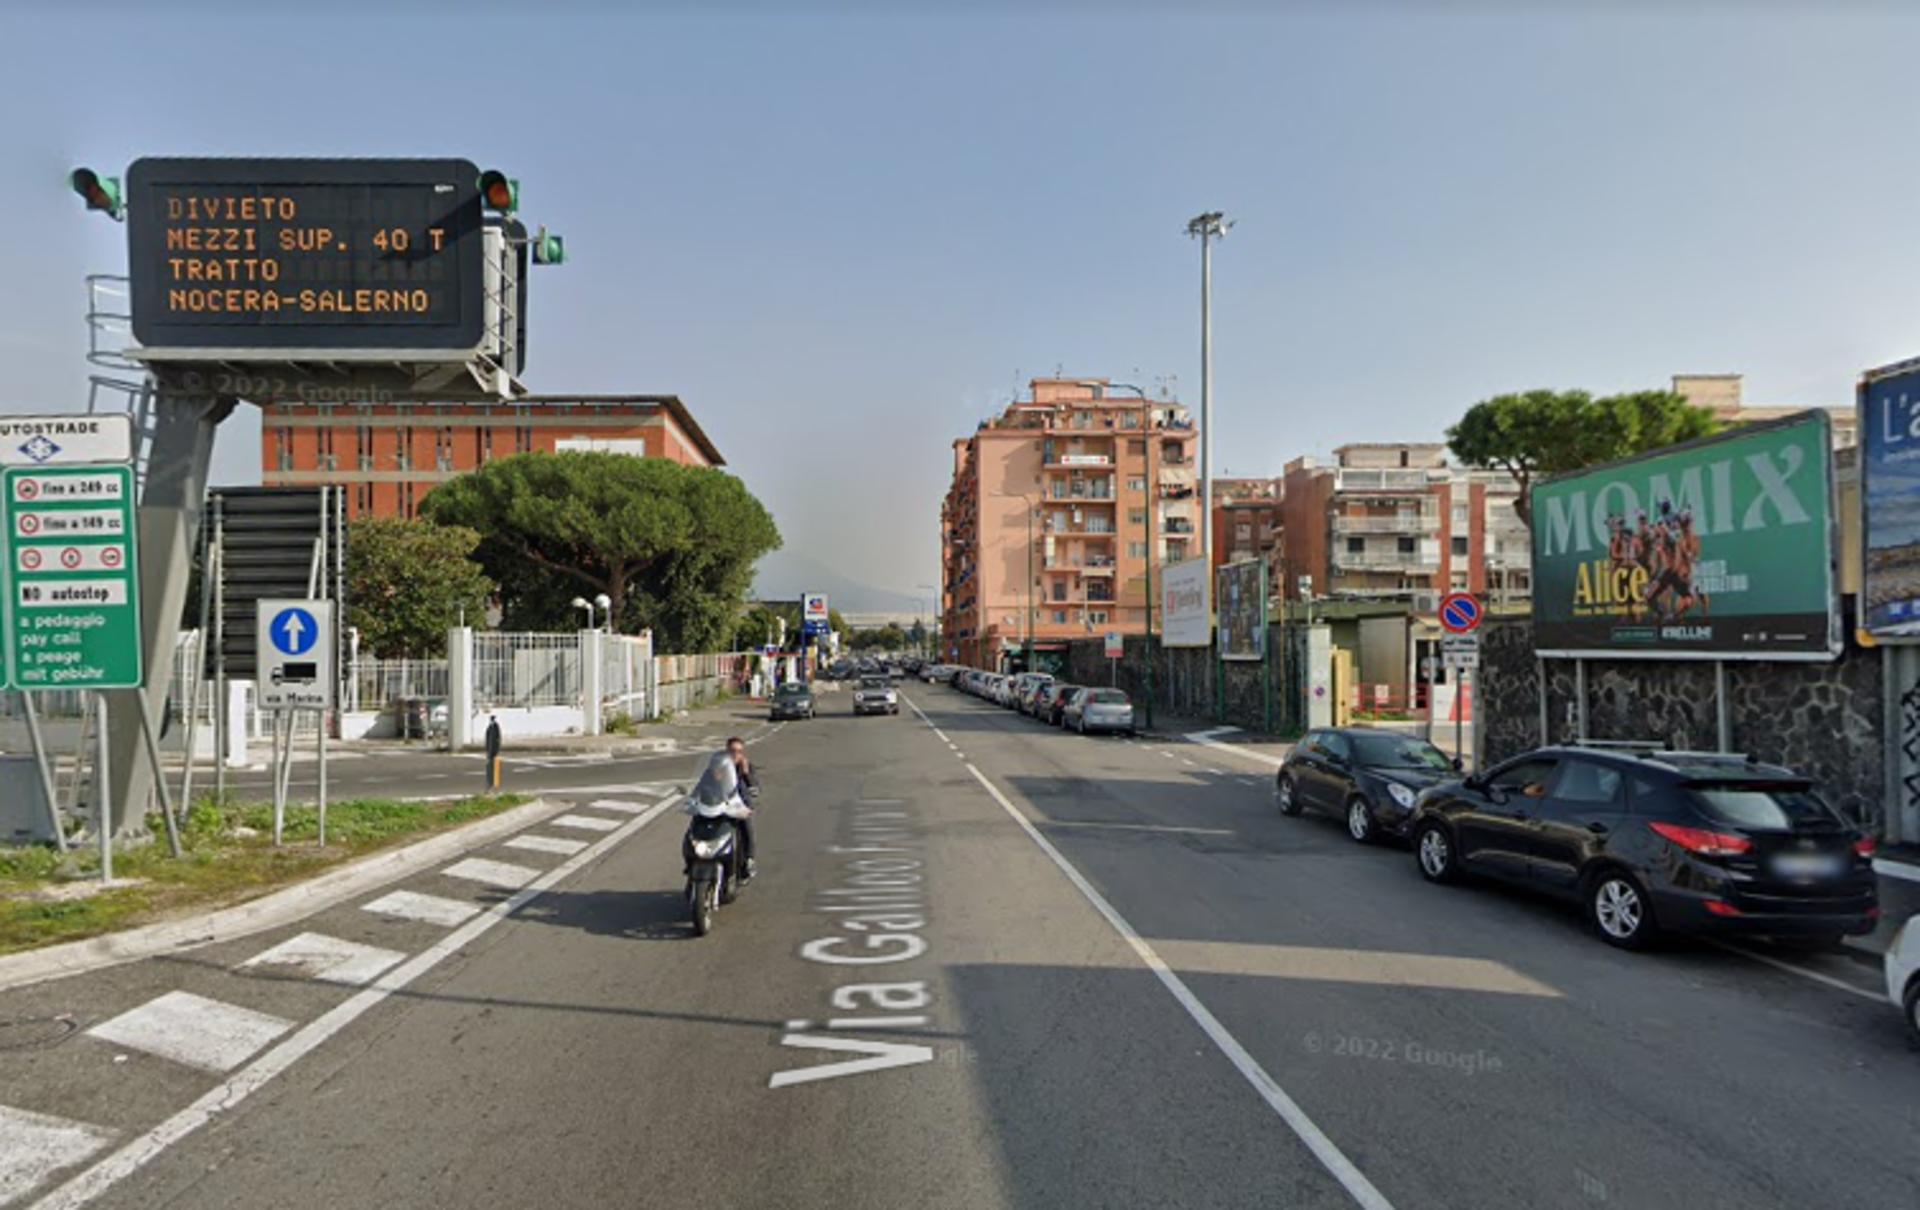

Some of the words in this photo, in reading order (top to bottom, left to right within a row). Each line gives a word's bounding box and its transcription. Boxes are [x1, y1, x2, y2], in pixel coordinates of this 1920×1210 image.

[168, 197, 296, 220] DIVIETO
[168, 227, 257, 251] MEZZI
[280, 227, 348, 251] SUP.
[373, 227, 409, 251] 40
[430, 228, 445, 251] T
[169, 259, 279, 281] TRATTO
[170, 289, 429, 312] NOCERA-SALERNO
[1544, 444, 1812, 557] MOMIX
[51, 586, 109, 602] autostop
[1573, 560, 1650, 607] Alice
[19, 616, 30, 628] a
[35, 613, 106, 630] pedaggio
[20, 633, 48, 648] pay
[52, 631, 82, 645] call
[22, 667, 47, 681] mit
